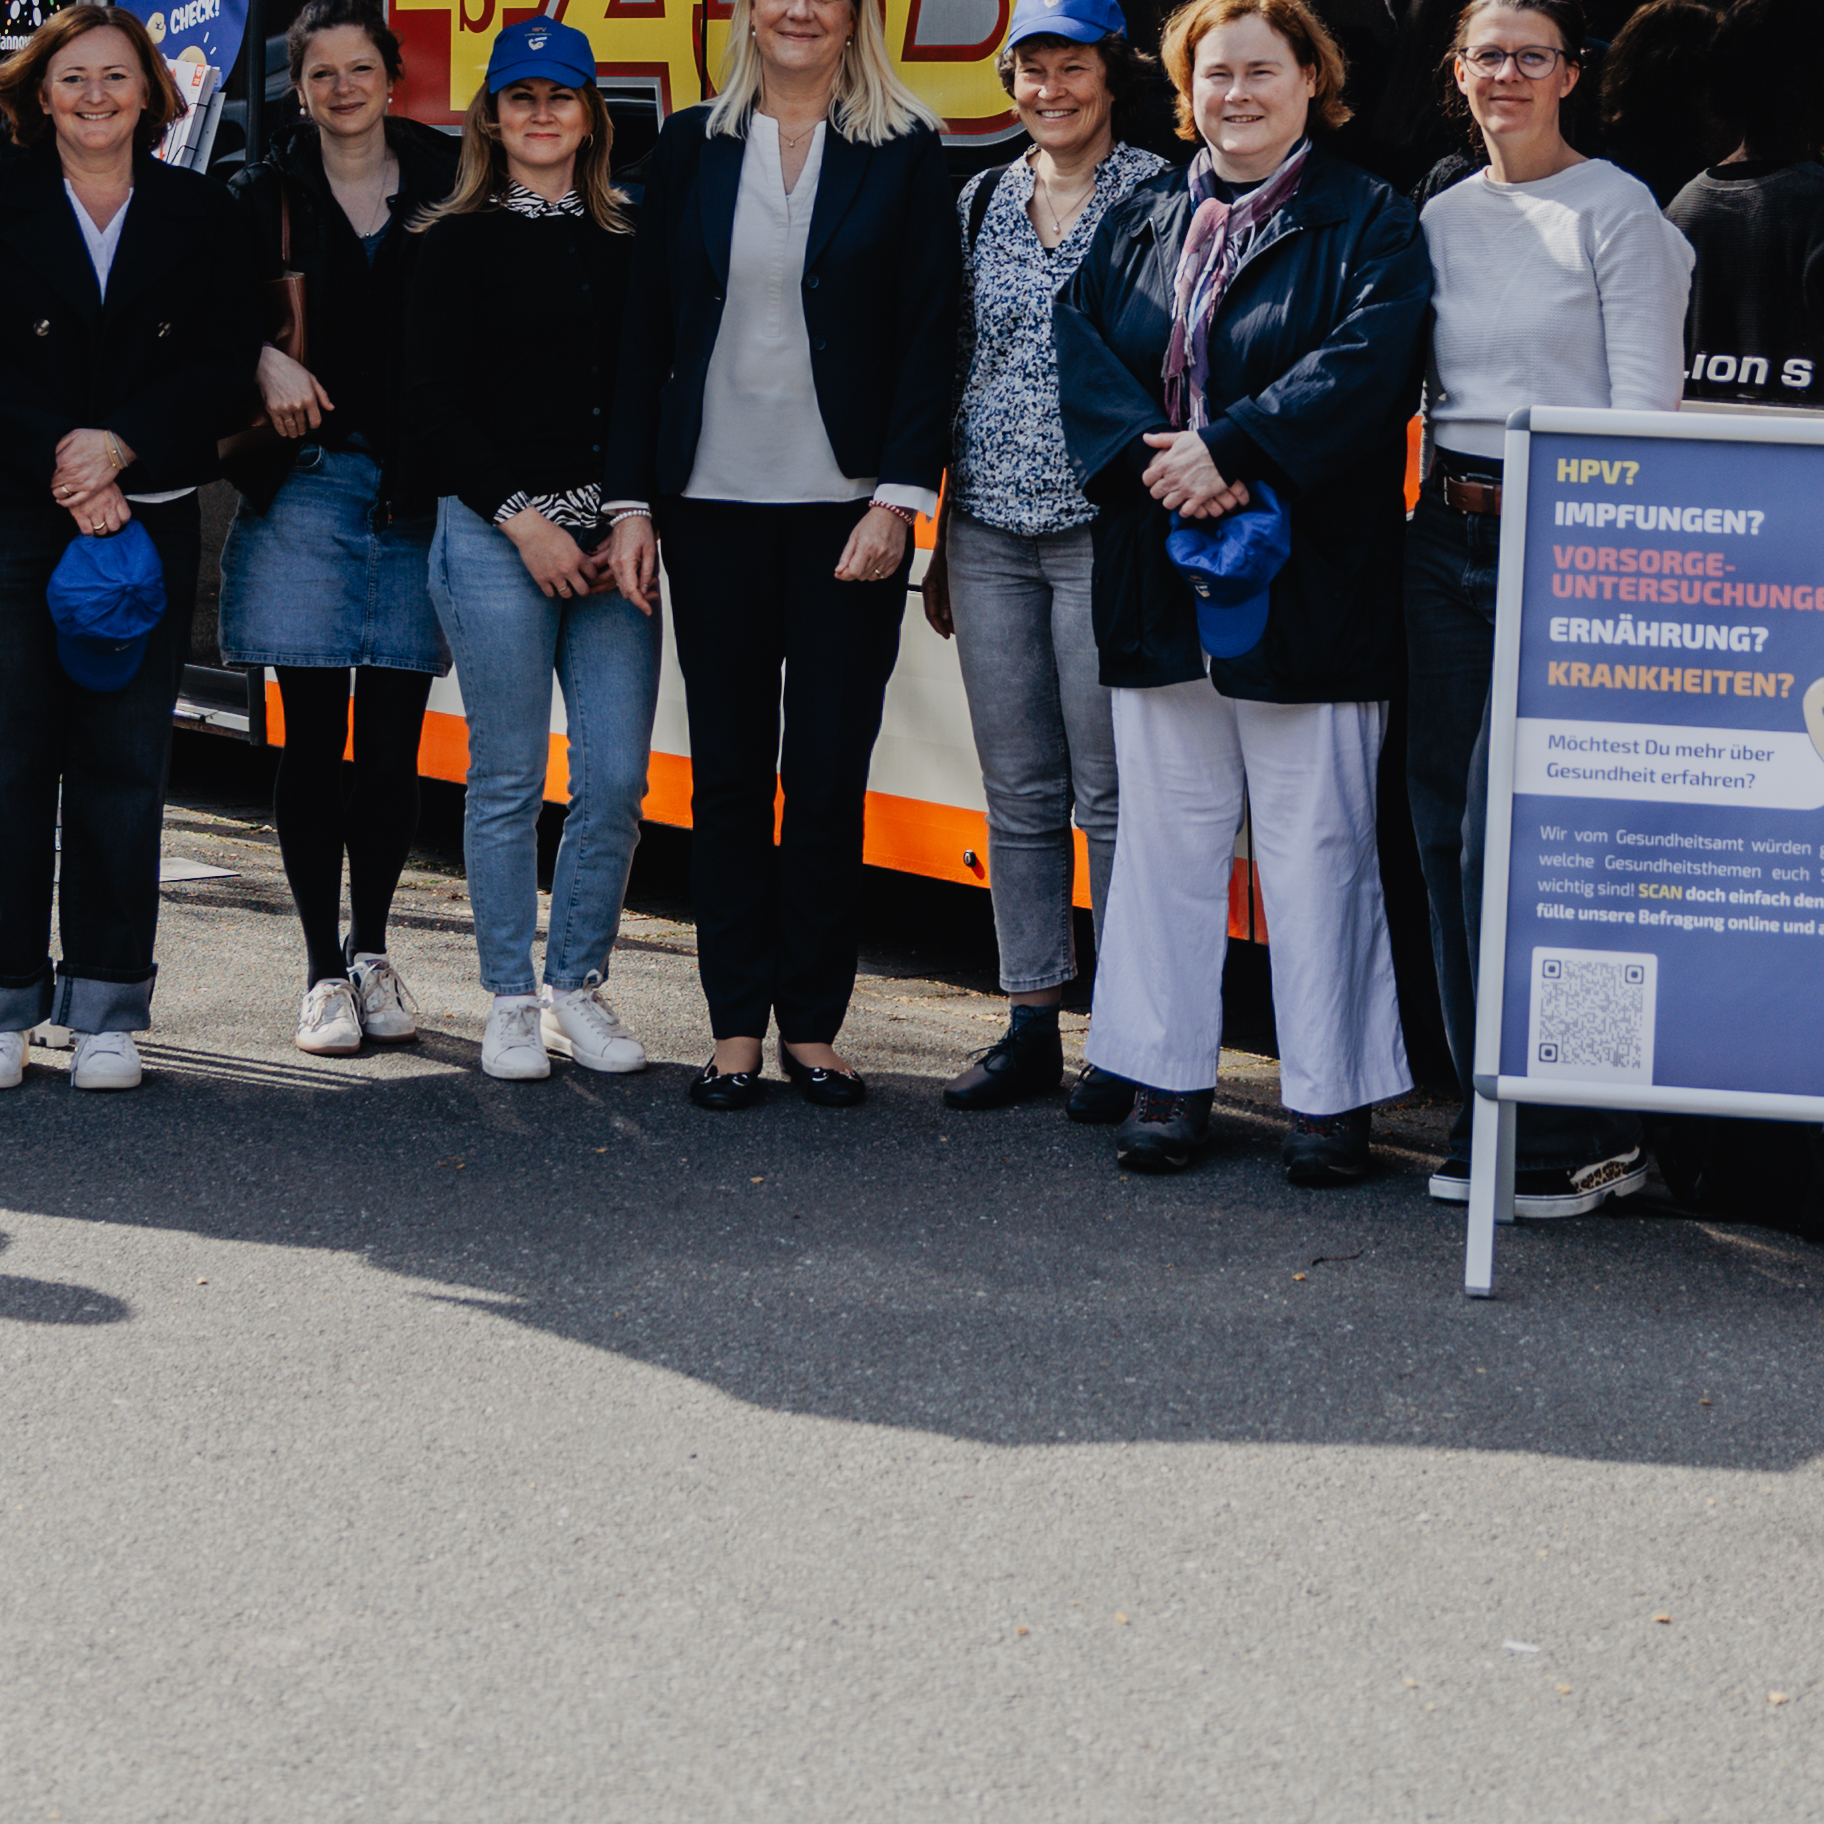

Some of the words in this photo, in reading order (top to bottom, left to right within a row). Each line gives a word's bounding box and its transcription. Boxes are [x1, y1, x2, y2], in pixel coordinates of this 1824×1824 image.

[1684, 354, 1769, 385] ion
[1556, 457, 1640, 486] HPV?
[1553, 500, 1765, 535] IMPFUNGEN?
[1553, 544, 1736, 577] VORSORGE-
[1549, 613, 1769, 653] ERNÄHRUNG?
[1547, 660, 1794, 699] KRANKHEITEN?
[1547, 733, 1640, 760] Möchtest
[1645, 738, 1671, 760] Du
[1674, 739, 1725, 763] mehr
[1729, 742, 1775, 764] über
[1546, 761, 1656, 786] Gesundheit
[1660, 766, 1756, 790] erfahren?
[1539, 825, 1568, 841] Wir
[1574, 830, 1609, 844] vom
[1615, 829, 1745, 852] Gesundheitsamt
[1751, 838, 1812, 856] würden
[1538, 852, 1595, 869] welche
[1604, 854, 1762, 880] Gesundheitsthemen
[1772, 867, 1810, 882] euch
[1537, 878, 1595, 899] wichtig
[1597, 881, 1635, 897] sind!
[1638, 883, 1683, 901] SCAN
[1685, 886, 1726, 904] doch
[1728, 888, 1791, 907] einfach
[1793, 892, 1824, 909] den
[1536, 902, 1575, 920] fülle
[1578, 908, 1635, 924] unsere
[1638, 909, 1725, 933] Befragung
[1727, 915, 1780, 933] online
[1783, 919, 1815, 935] und
